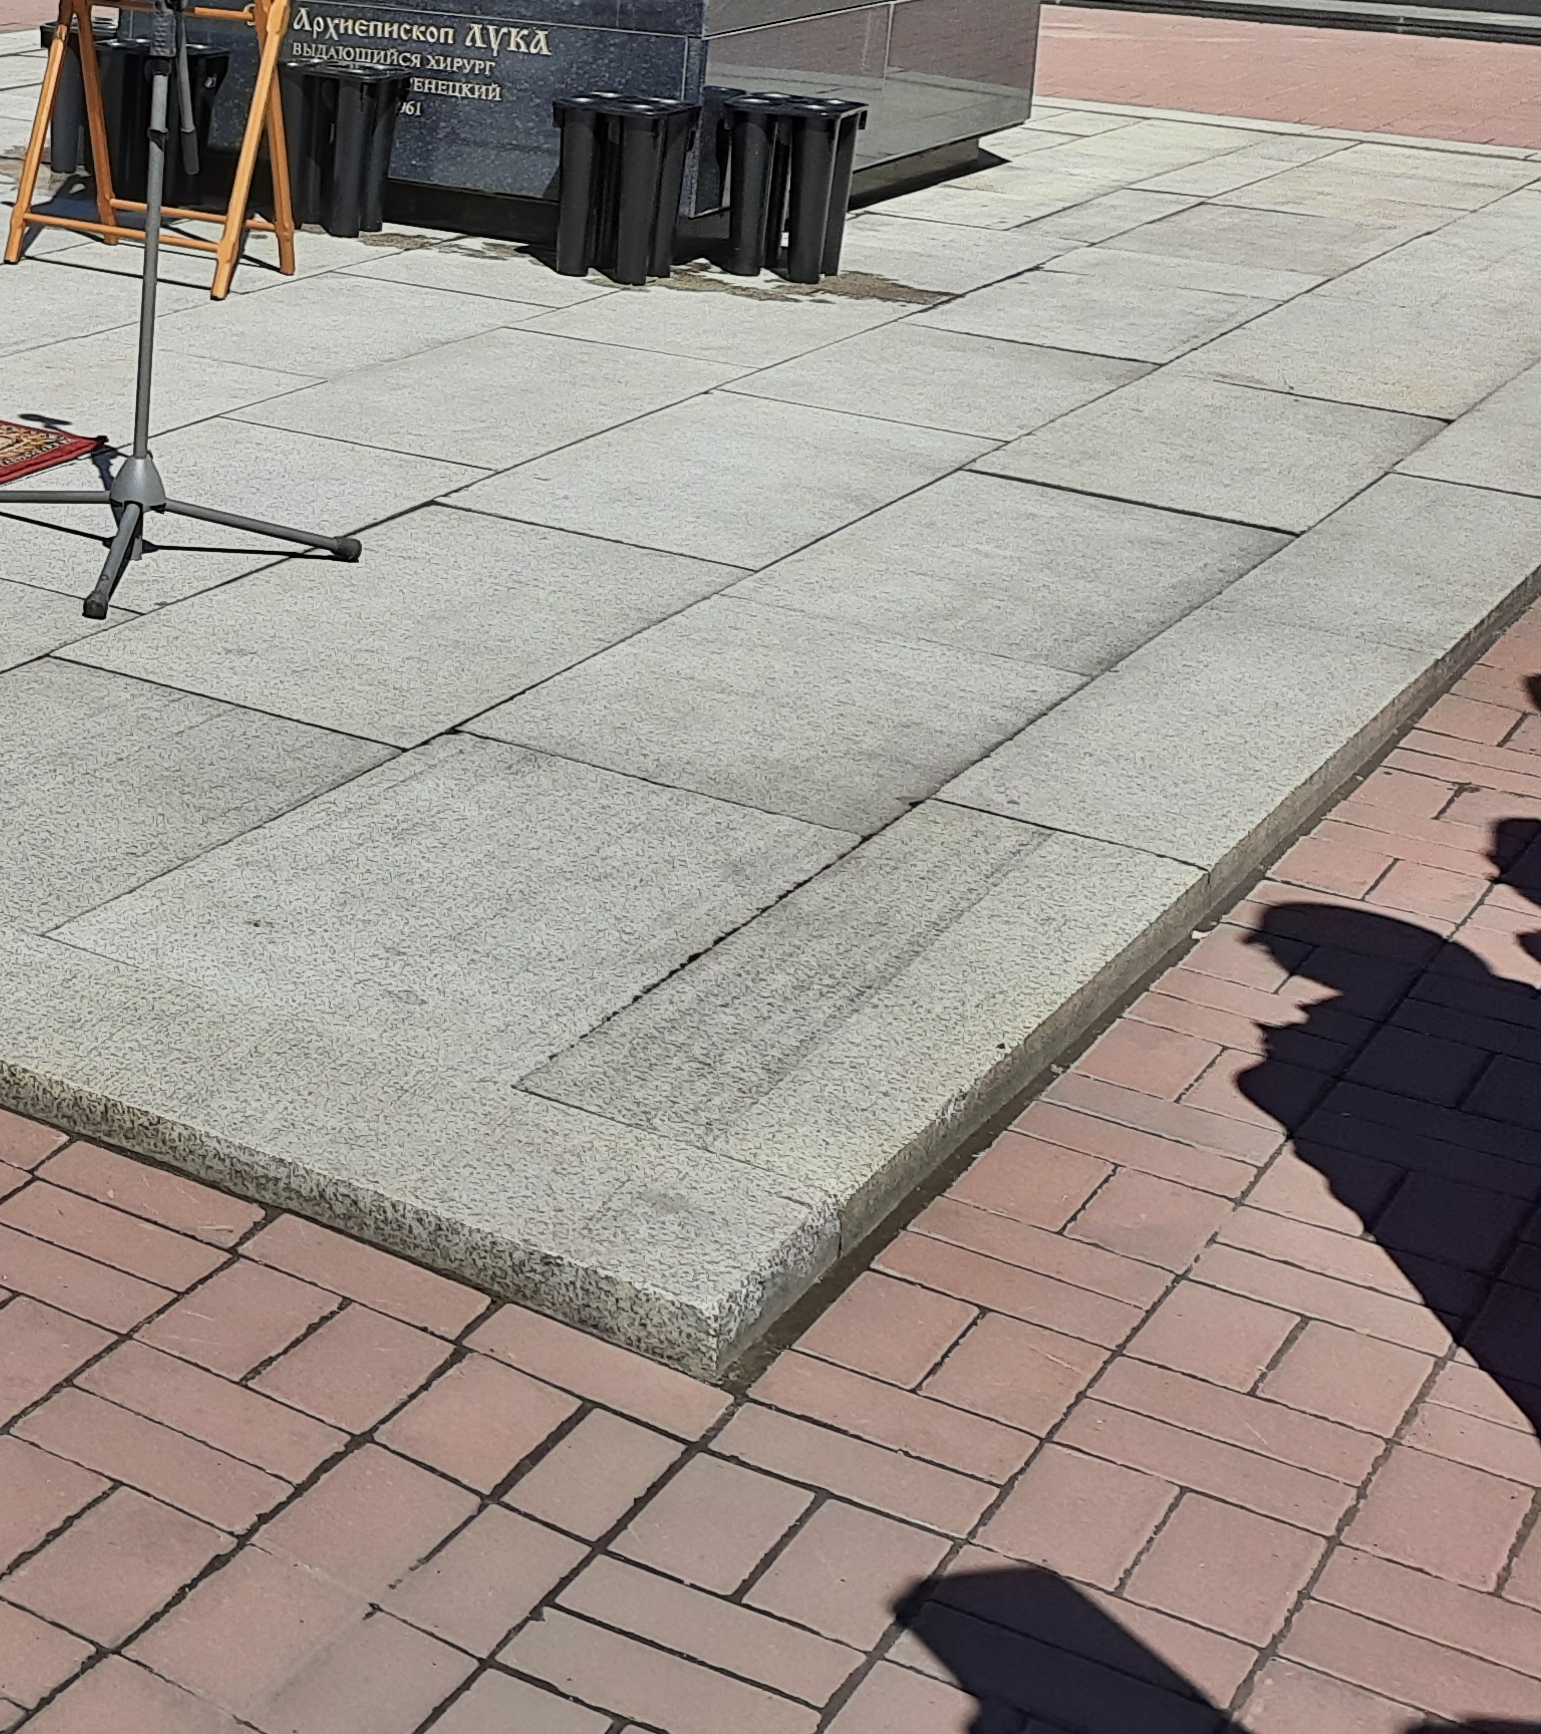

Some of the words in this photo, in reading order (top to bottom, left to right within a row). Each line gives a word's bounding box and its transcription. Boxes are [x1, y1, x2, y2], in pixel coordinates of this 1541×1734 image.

[292, 7, 454, 44] Архиепископ
[426, 54, 496, 76] ХИРУРГ
[409, 77, 502, 102] ЕНЕЦКИЙ
